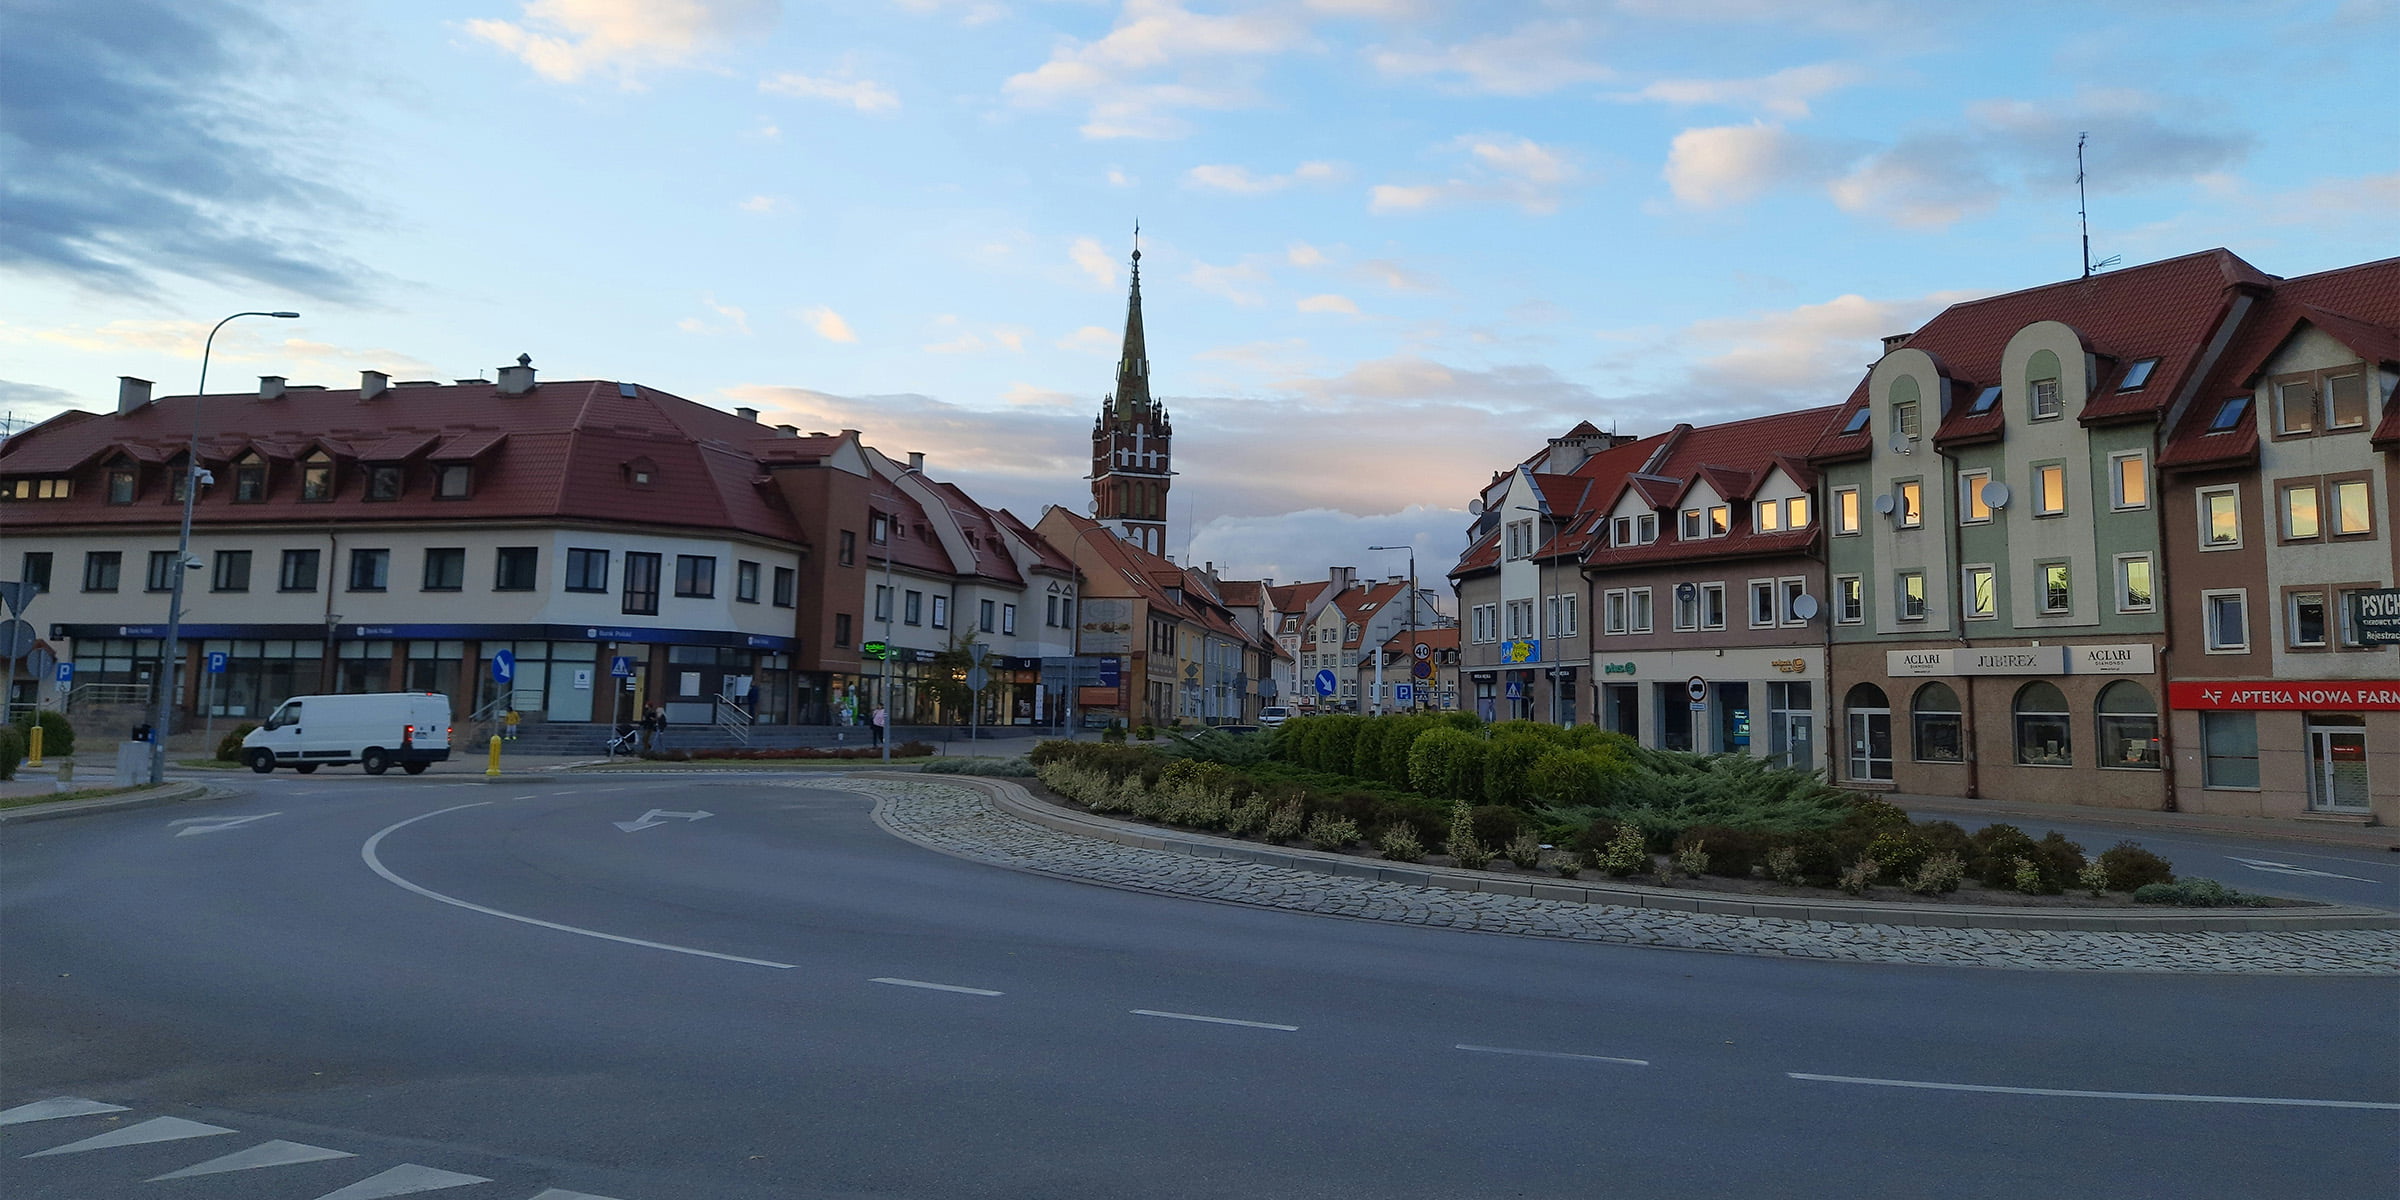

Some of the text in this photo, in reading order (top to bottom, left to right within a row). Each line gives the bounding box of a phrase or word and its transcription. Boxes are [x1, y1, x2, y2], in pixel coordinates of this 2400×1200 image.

[2361, 594, 2400, 617] PSYCH
[1415, 647, 1429, 656] 40
[2088, 650, 2131, 660] ACLARI
[212, 655, 223, 669] P
[1903, 654, 1940, 664] ACLARI
[1977, 654, 2037, 667] JUBIREX
[60, 664, 70, 679] P
[2230, 690, 2294, 703] APTEKA
[2298, 690, 2353, 703] NOWA
